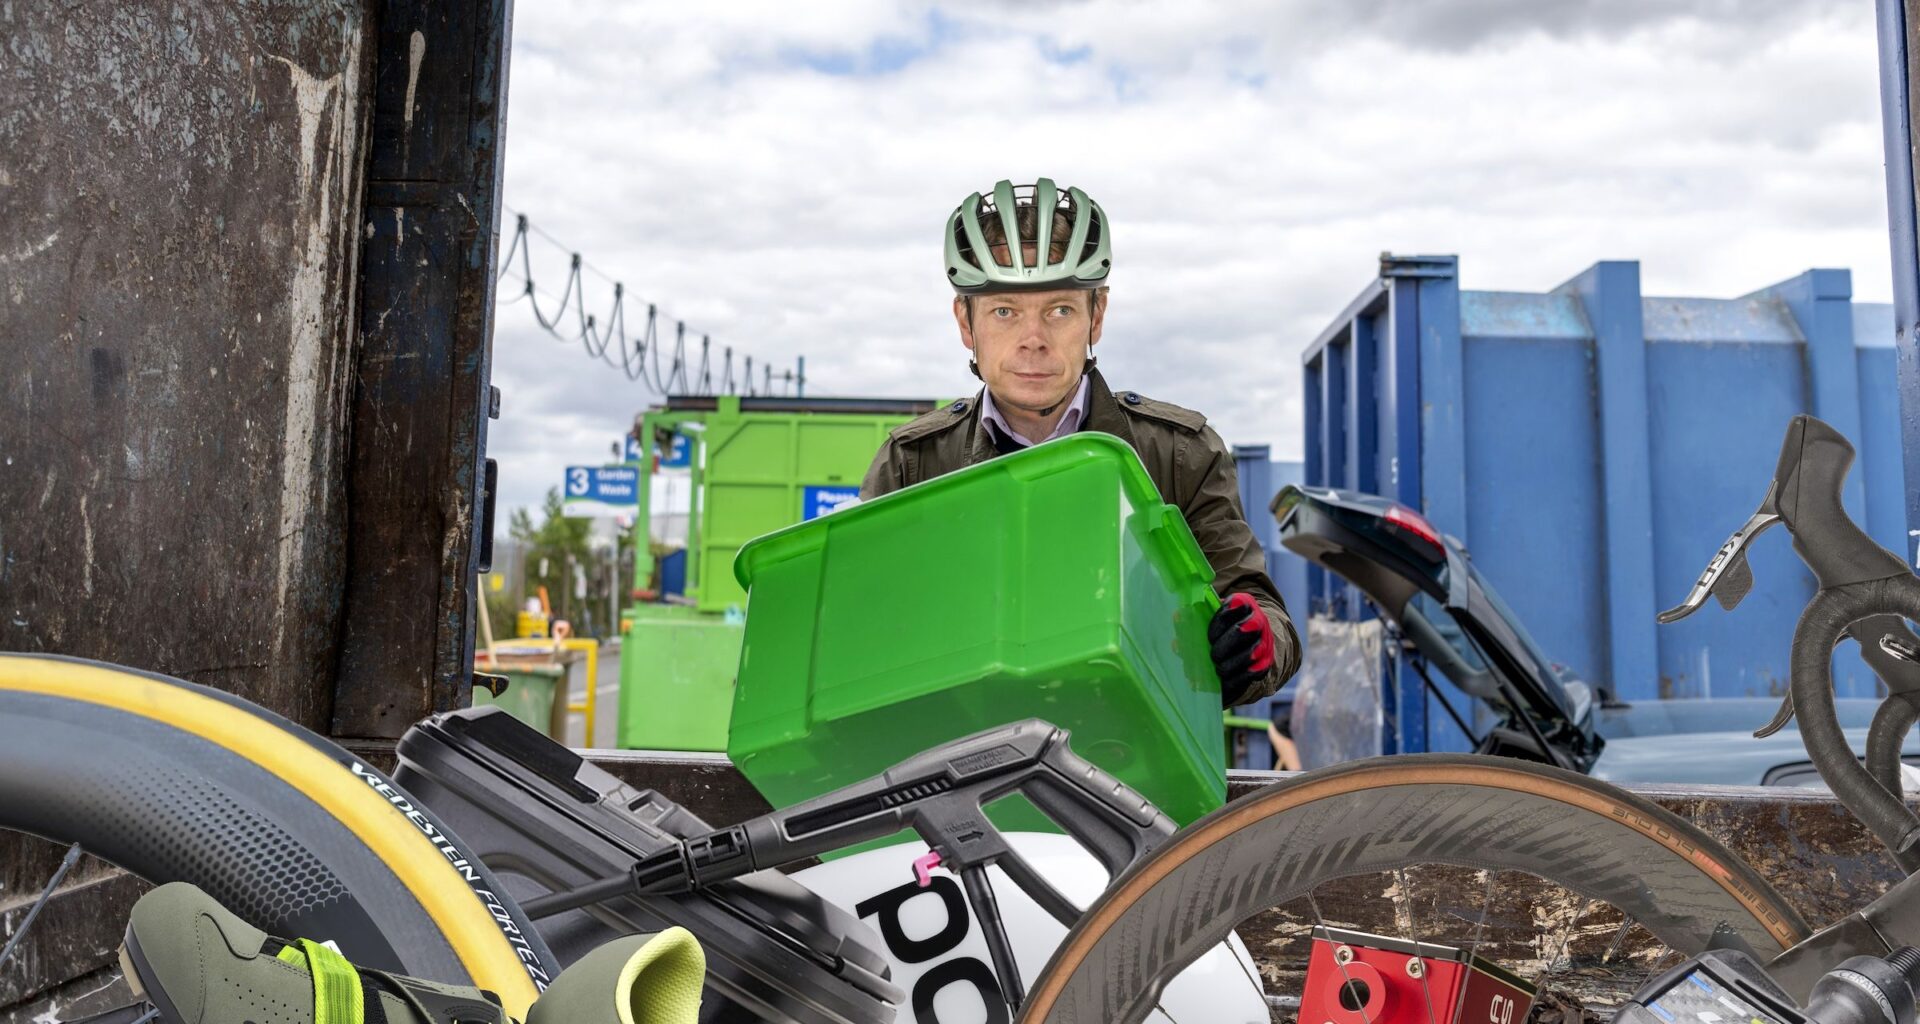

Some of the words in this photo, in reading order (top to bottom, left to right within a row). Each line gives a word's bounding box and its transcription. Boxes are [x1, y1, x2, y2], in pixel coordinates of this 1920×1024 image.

[569, 467, 590, 496] 3
[596, 469, 635, 481] Garden
[598, 484, 631, 497] Waste
[351, 761, 481, 881] VREDESTEIN
[1838, 971, 1890, 1009] CERAMIC
